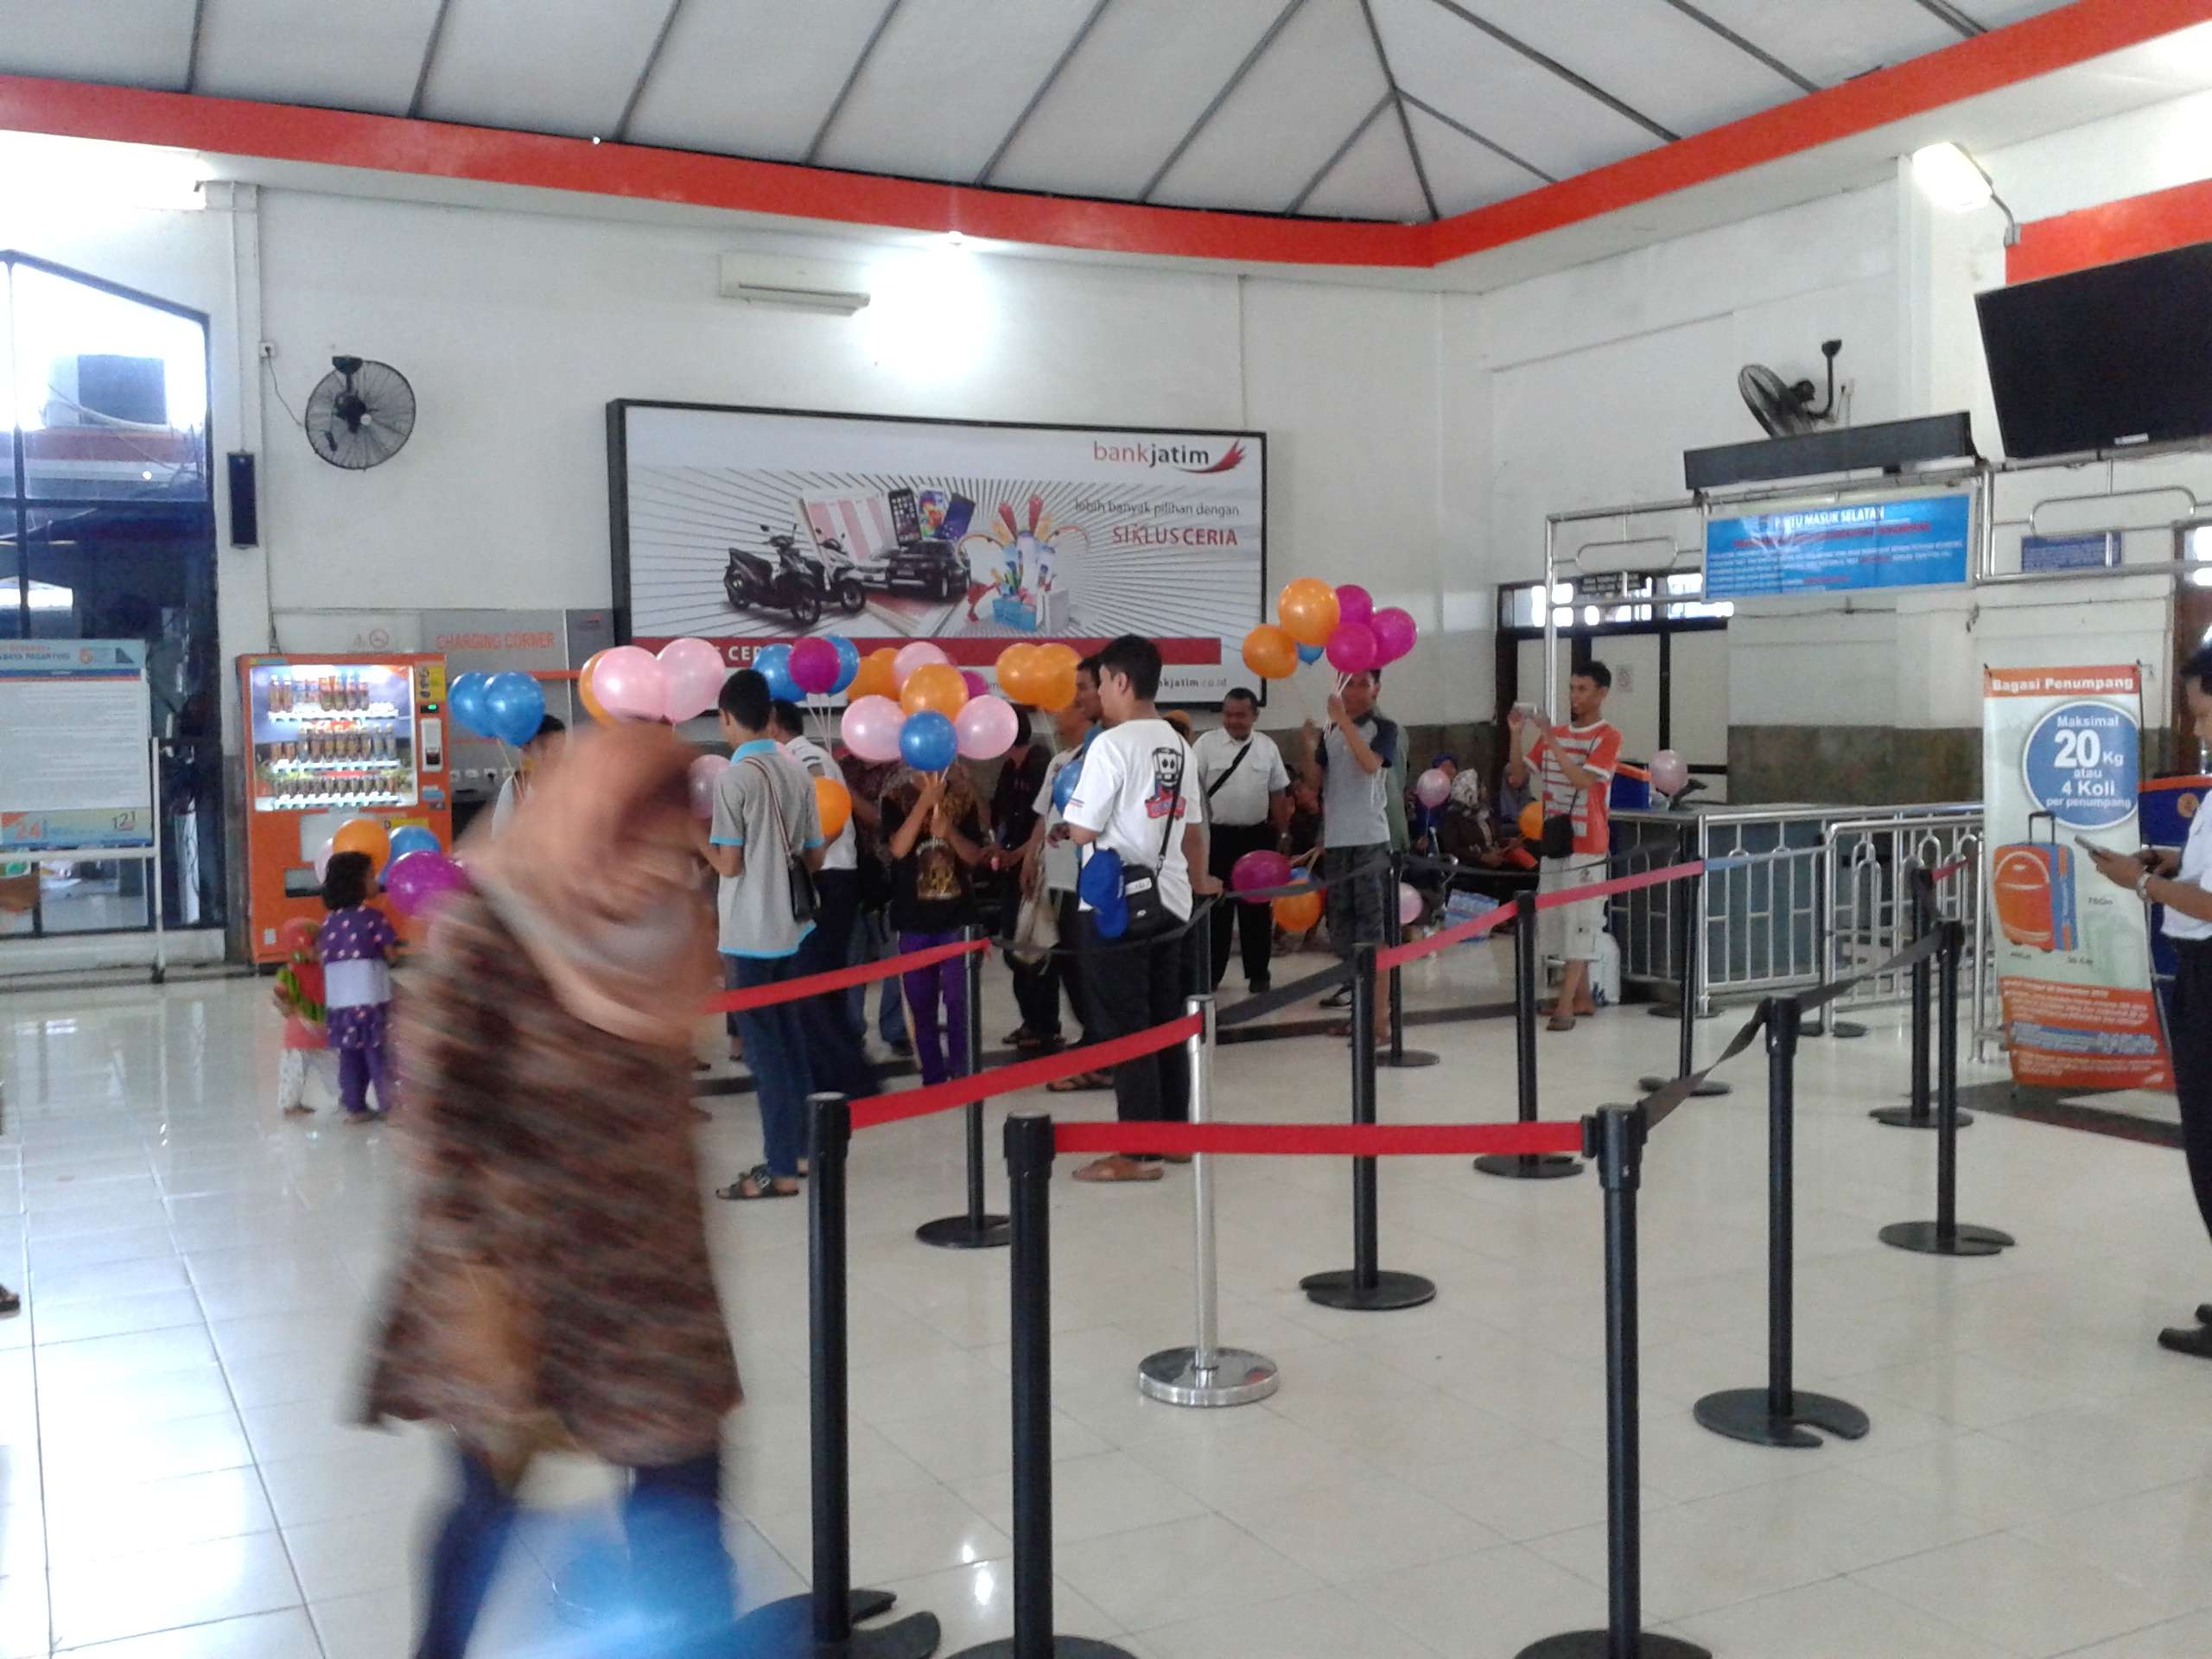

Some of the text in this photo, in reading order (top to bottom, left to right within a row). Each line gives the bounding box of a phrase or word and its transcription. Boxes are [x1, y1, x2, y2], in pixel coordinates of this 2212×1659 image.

[1094, 441, 1209, 467] bankjatim
[1154, 501, 1192, 518] pilihan
[1196, 502, 1239, 518] dengan
[1113, 525, 1237, 545] SIKLUS CERIA
[1991, 677, 2134, 694] Bagasi Penumpang
[2056, 715, 2120, 728] Maksimal
[2053, 728, 2125, 768] 20 Kg
[2073, 768, 2103, 779] atau
[2061, 779, 2116, 797] 4 Koli
[2046, 798, 2133, 810] per penumpang
